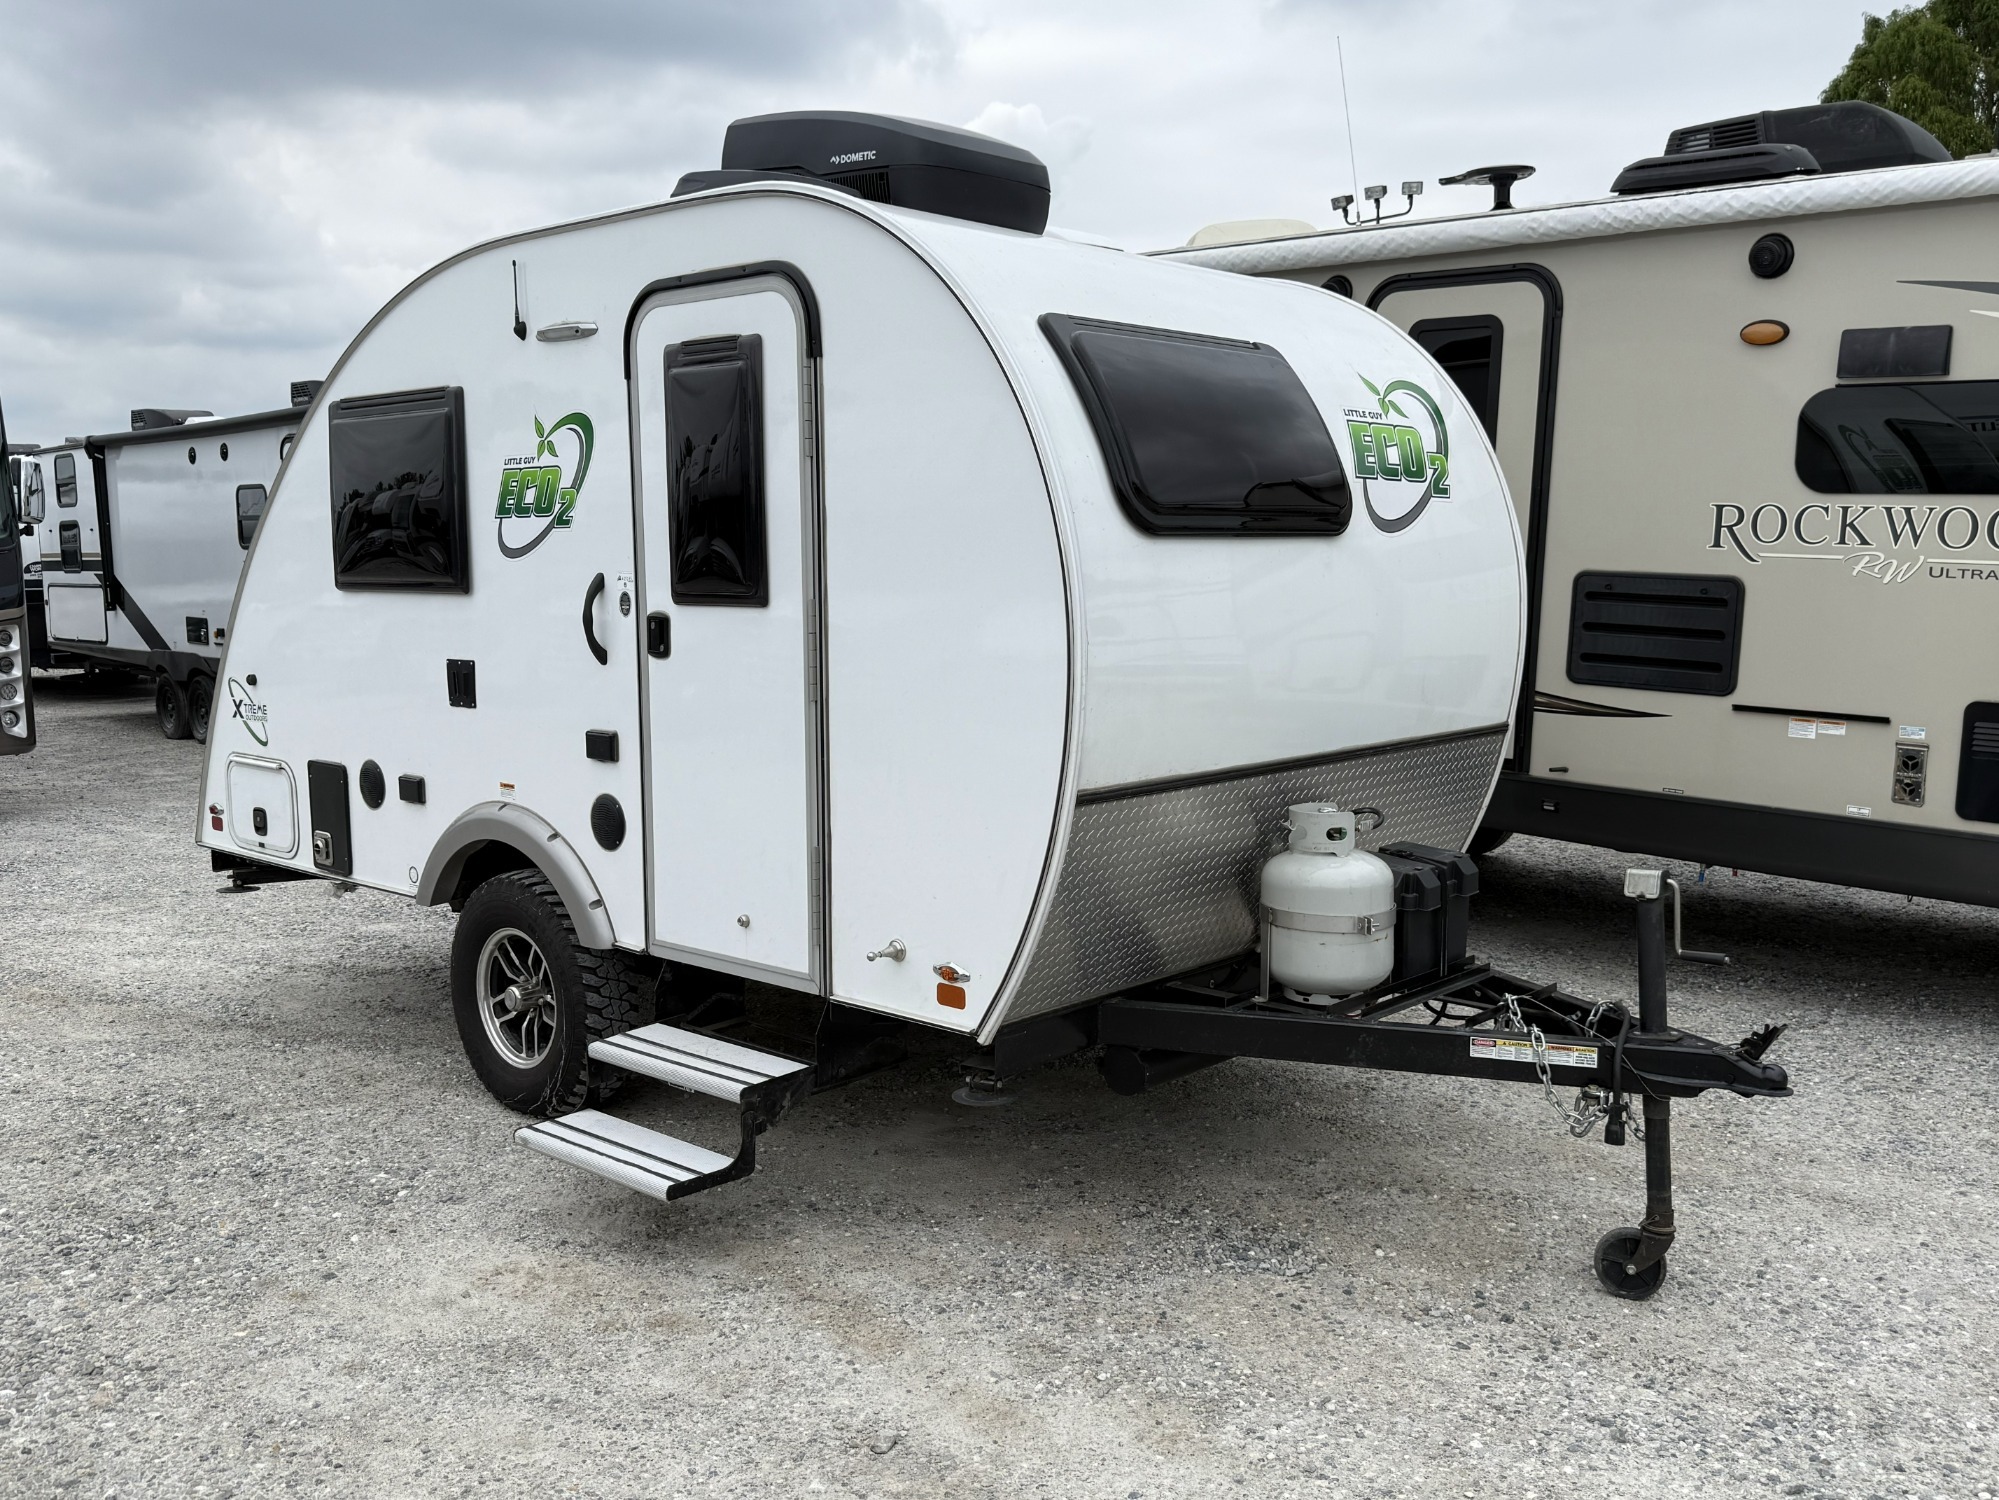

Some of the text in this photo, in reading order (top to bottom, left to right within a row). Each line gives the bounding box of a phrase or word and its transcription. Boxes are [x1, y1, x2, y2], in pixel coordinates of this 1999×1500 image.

[840, 150, 876, 164] DOMETIC
[1343, 408, 1383, 420] LITTLE GUY
[504, 456, 536, 466] LITTLE GUY
[1928, 566, 1999, 580] ULTRA
[232, 699, 268, 719] XTREME
[245, 714, 268, 722] OUTDOORS
